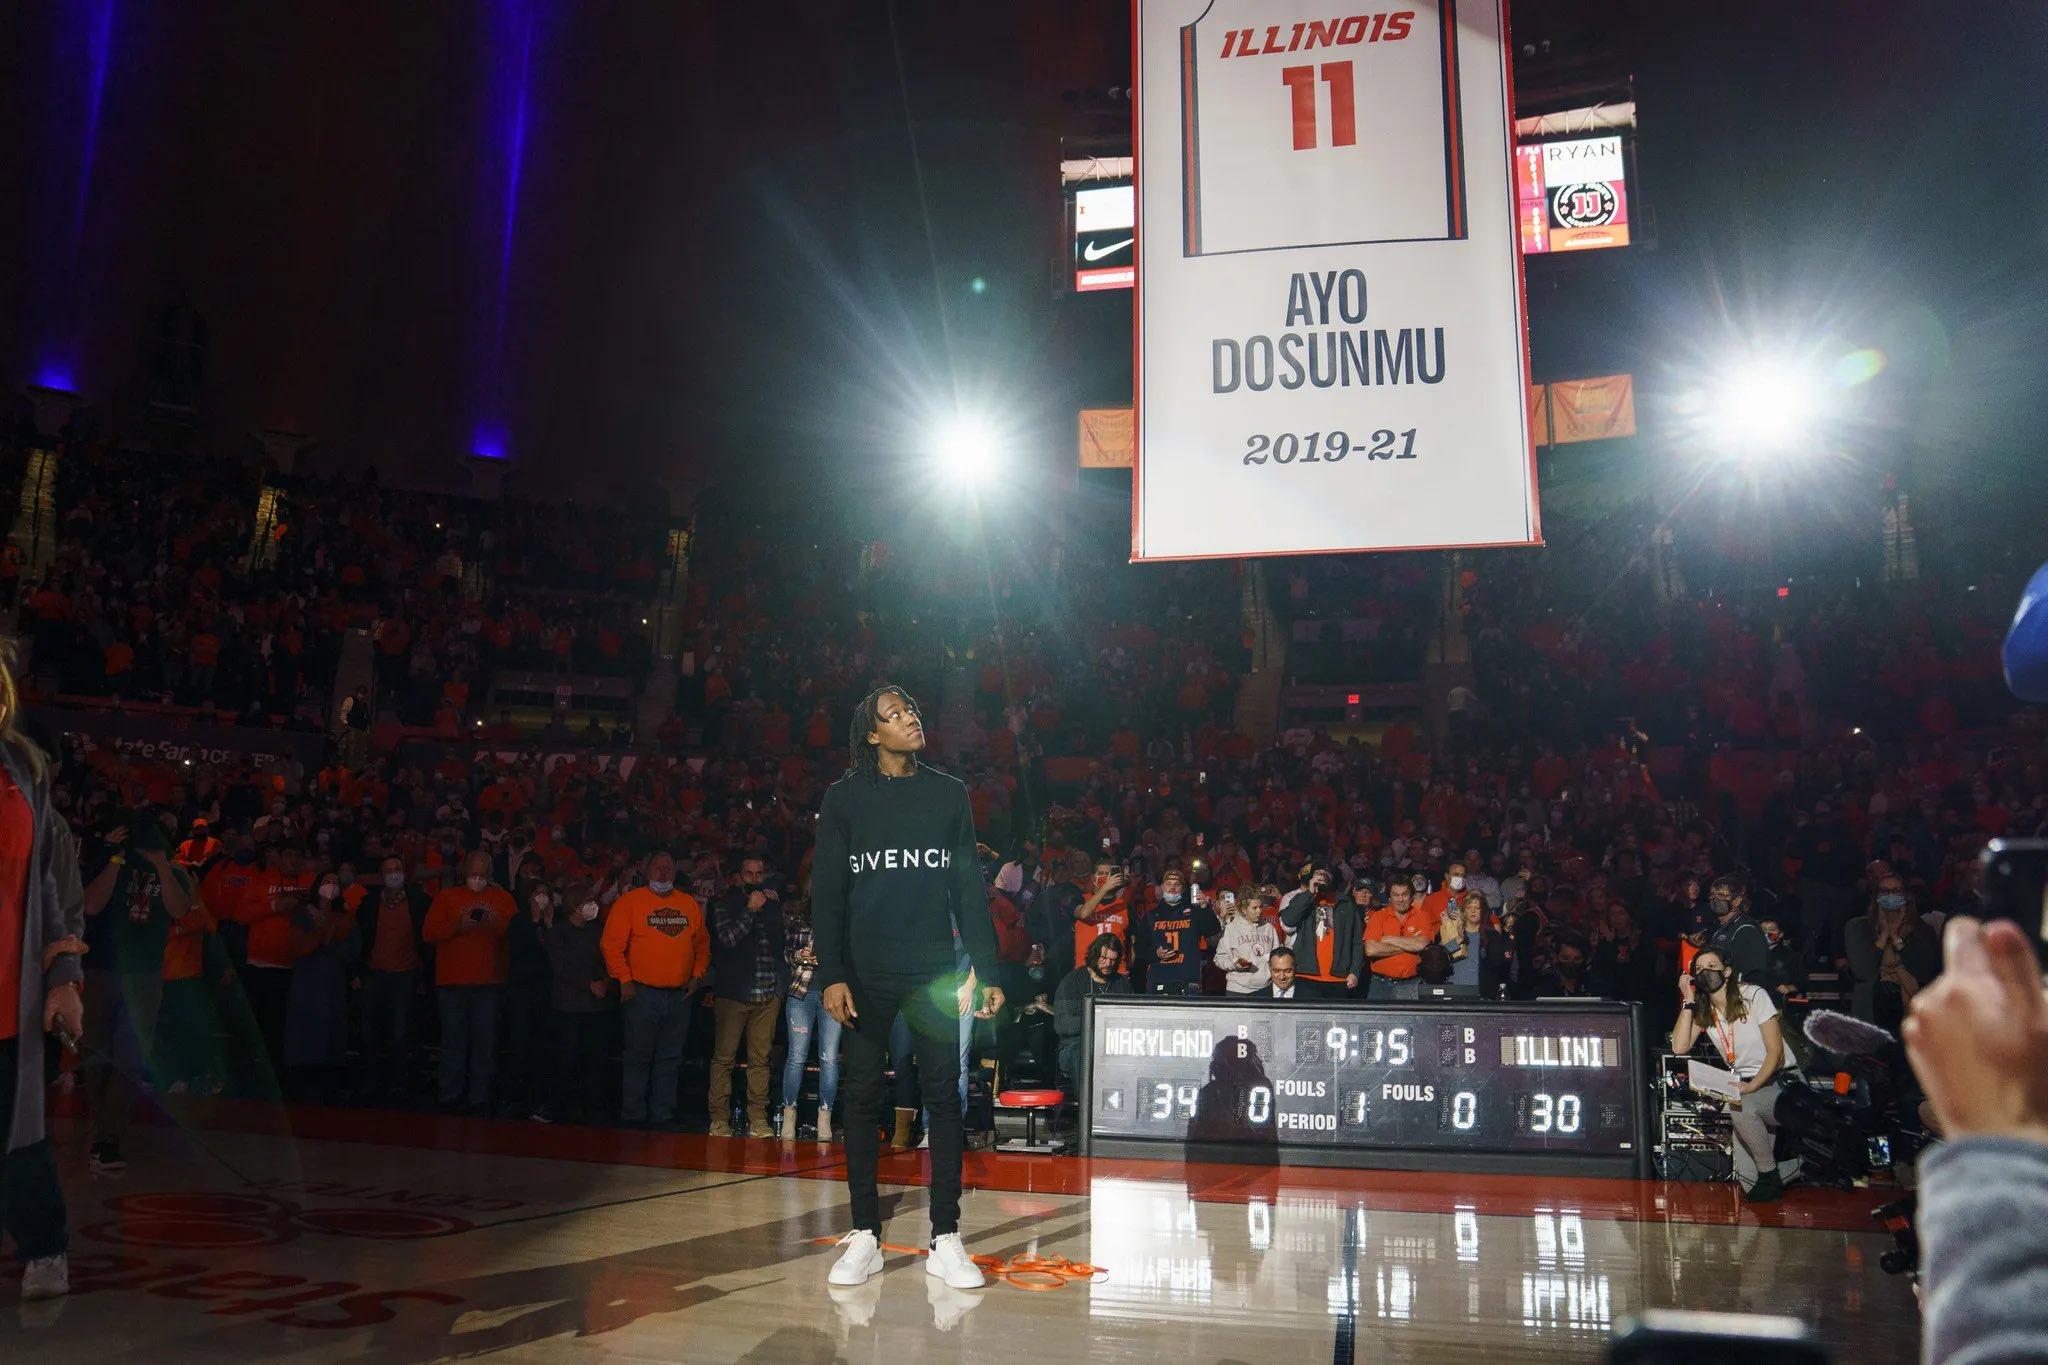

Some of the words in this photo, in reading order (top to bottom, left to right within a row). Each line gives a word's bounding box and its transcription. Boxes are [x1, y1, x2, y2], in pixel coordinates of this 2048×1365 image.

[1220, 11, 1415, 58] ILLINOIS
[1282, 60, 1357, 150] 11
[1550, 142, 1616, 161] RYAN
[1285, 268, 1368, 327] AYO
[1212, 327, 1446, 394] DOSUNMU
[1243, 428, 1418, 466] 2019-21
[1105, 1028, 1213, 1057] MARYLAND
[1237, 1024, 1248, 1040] B
[1326, 1026, 1409, 1065] 9:15
[1464, 1027, 1475, 1044] B
[1237, 1043, 1248, 1059] B
[1464, 1048, 1476, 1064] B
[1516, 1036, 1601, 1067] ILLINI
[1152, 1083, 1198, 1119] 34
[1248, 1086, 1271, 1123] 0
[1275, 1079, 1326, 1097] FOULS
[1382, 1083, 1435, 1102] FOULS
[1277, 1112, 1337, 1131] PERIOD
[1452, 1091, 1477, 1130] 0
[1530, 1093, 1581, 1133] 30
